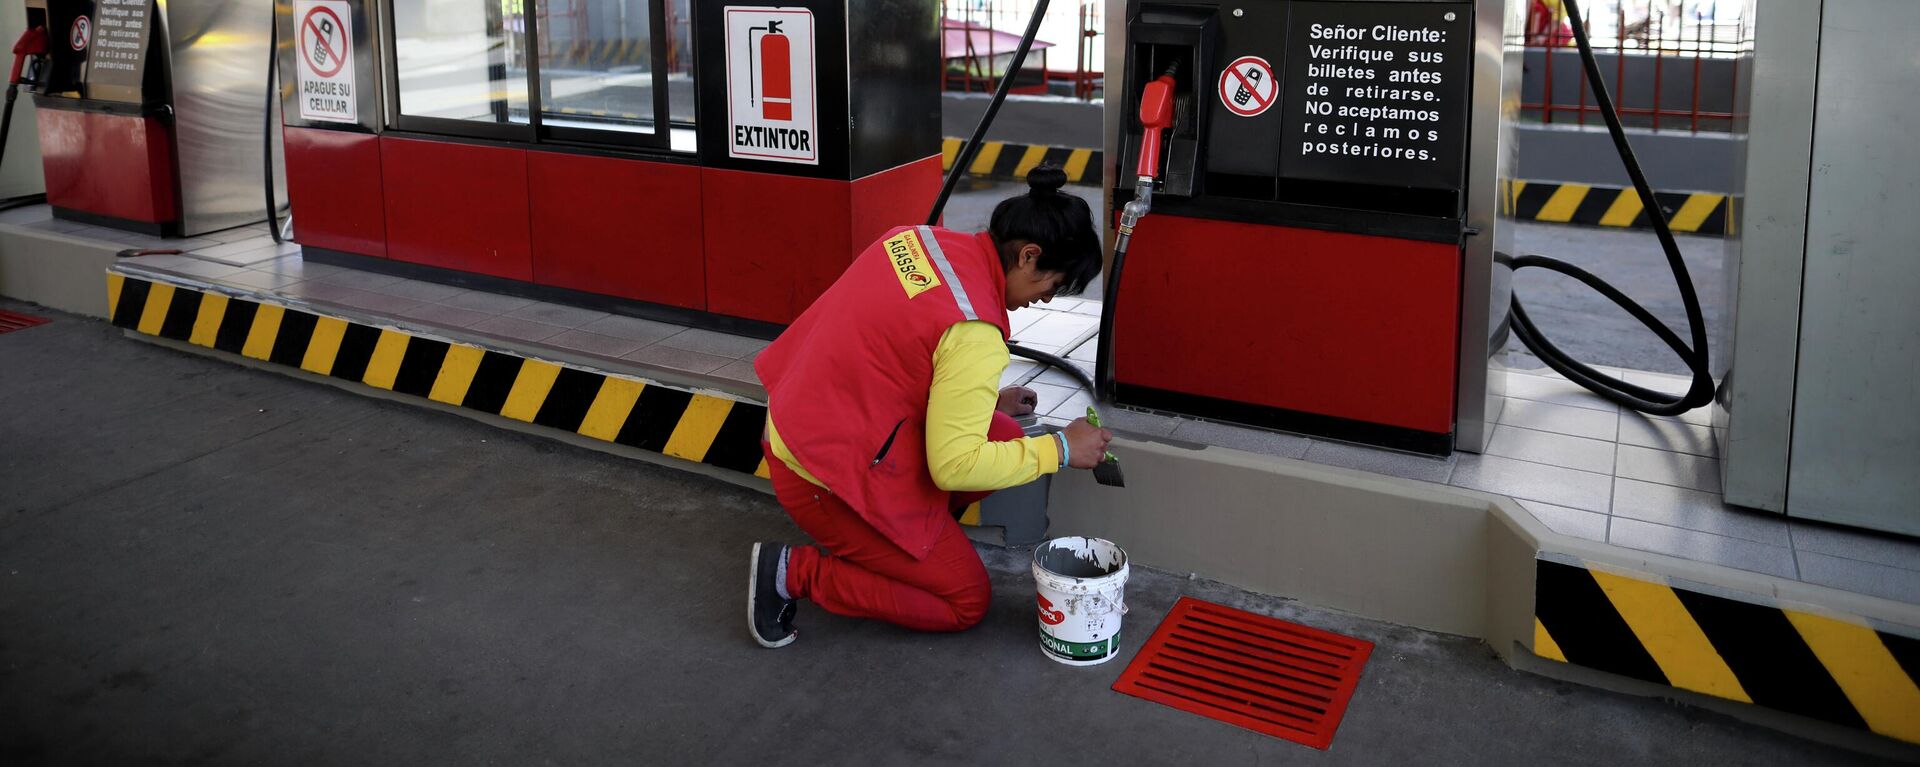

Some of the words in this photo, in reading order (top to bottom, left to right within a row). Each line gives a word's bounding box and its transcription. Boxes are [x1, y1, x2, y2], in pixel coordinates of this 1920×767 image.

[102, 7, 129, 18] Verifique
[100, 18, 122, 27] billetes
[125, 20, 142, 28] antes
[110, 30, 140, 38] retirarse.
[1310, 23, 1366, 40] Señor
[1371, 25, 1446, 42] Cliente:
[97, 39, 107, 47] NO
[108, 40, 139, 49] aceptamos
[96, 50, 138, 59] reclamos
[1309, 44, 1394, 63] Verifique
[1408, 51, 1443, 63] sus
[95, 61, 136, 70] posteriores.
[1308, 63, 1375, 79] billetes
[1389, 68, 1442, 84] antes
[304, 80, 337, 95] APAGUE
[338, 83, 351, 96] SU
[1306, 82, 1329, 96] de
[1346, 86, 1440, 102] retirarse.
[310, 97, 347, 113] CELULAR
[1305, 101, 1333, 115] NO
[1338, 105, 1439, 122] aceptamos
[735, 125, 810, 151] EXTINTOR
[1304, 122, 1438, 141] reclamos
[1302, 141, 1436, 161] posteriores.
